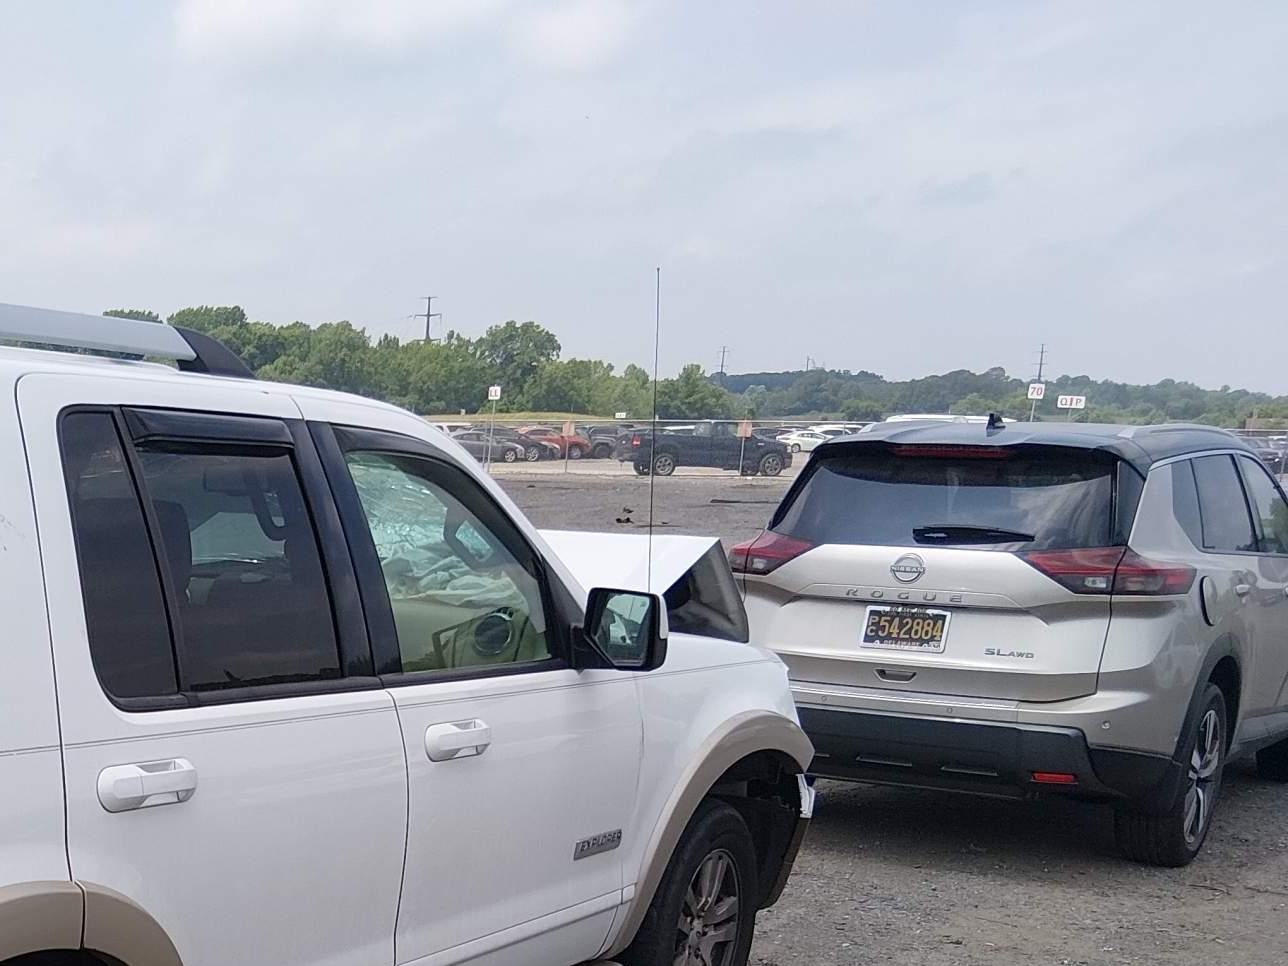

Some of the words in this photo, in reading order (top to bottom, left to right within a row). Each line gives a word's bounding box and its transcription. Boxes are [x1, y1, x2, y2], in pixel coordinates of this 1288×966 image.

[1030, 387, 1043, 396] 70
[846, 588, 962, 602] ROGUE
[879, 617, 943, 640] 542884
